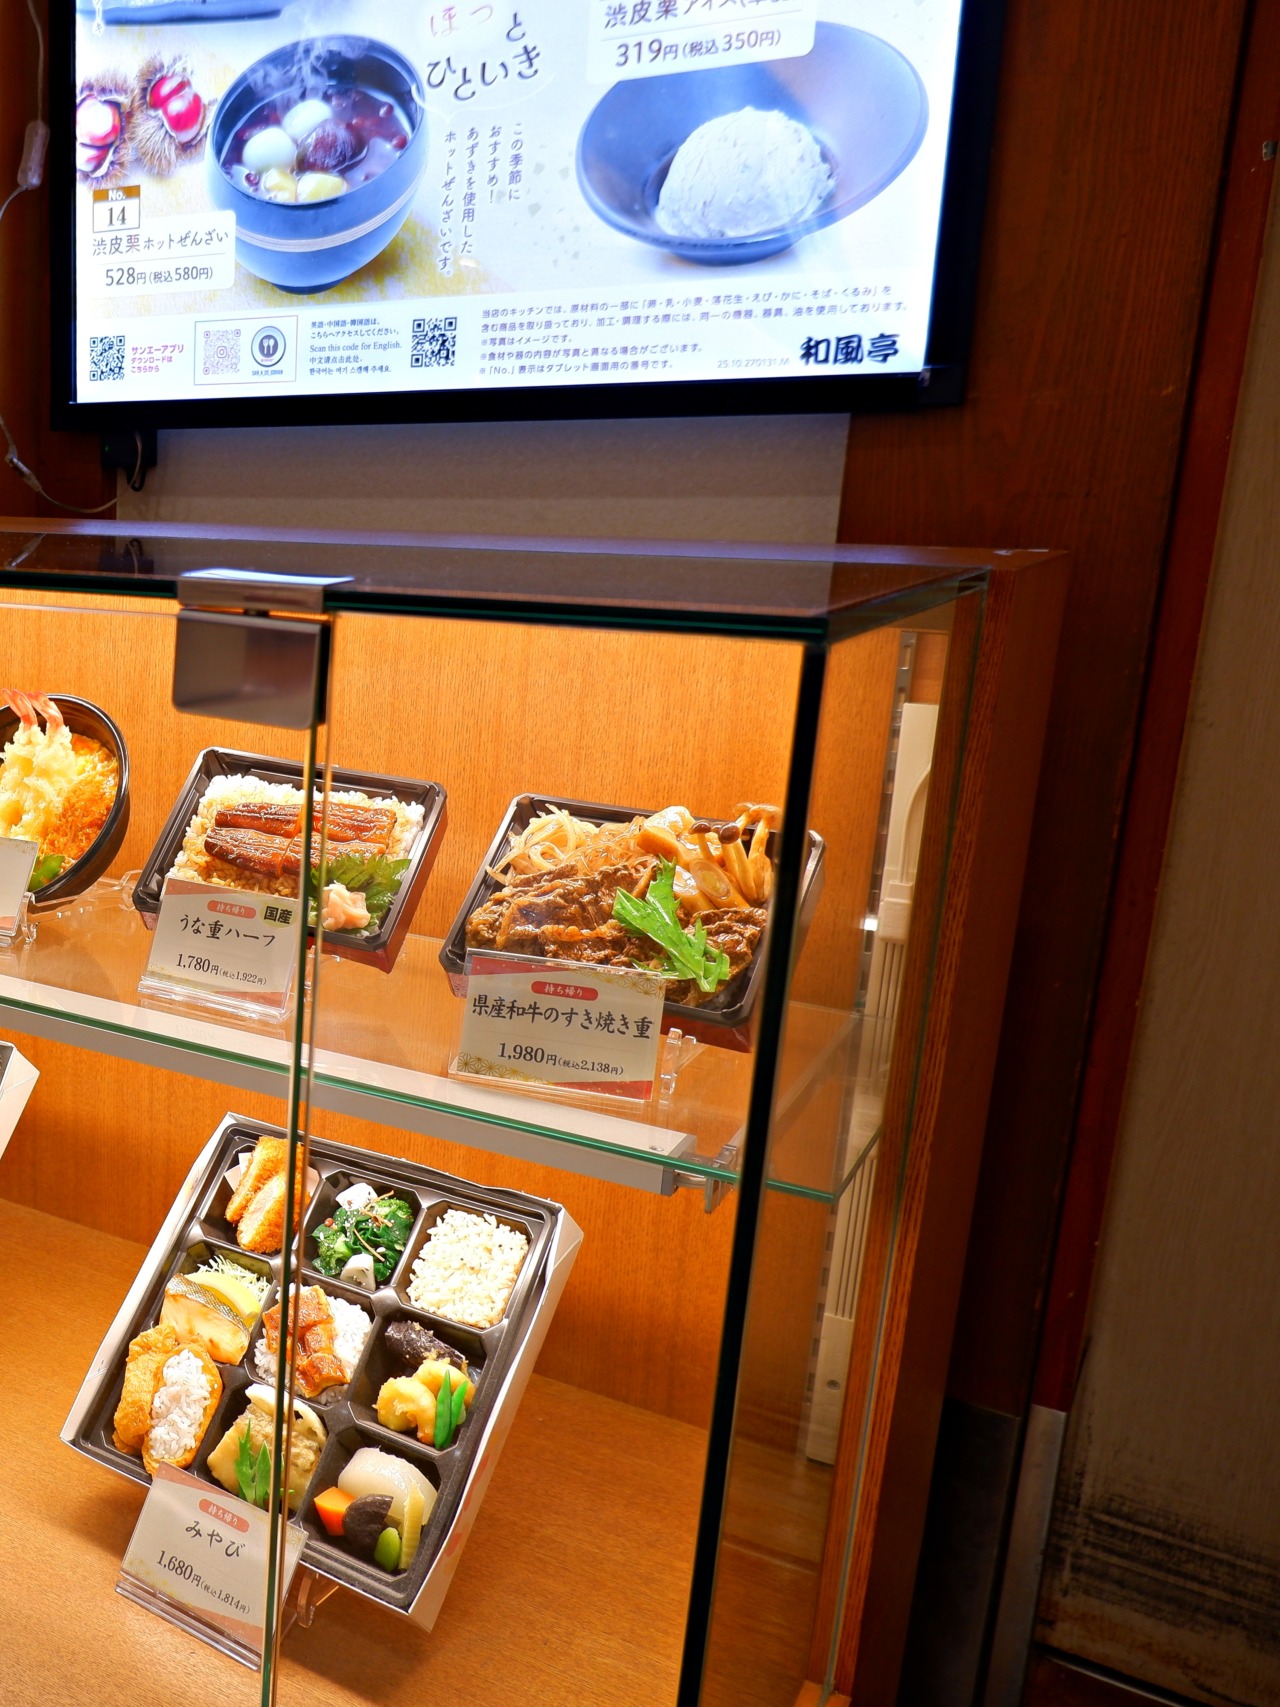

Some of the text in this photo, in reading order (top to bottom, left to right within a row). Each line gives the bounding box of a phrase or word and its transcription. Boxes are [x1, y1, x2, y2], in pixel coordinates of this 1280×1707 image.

[615, 29, 782, 67] 319円(税込350円)
[426, 44, 541, 101] ひといき
[507, 122, 524, 201] この季節に
[108, 190, 126, 201] No.
[438, 131, 457, 275] ホットぜんざいです。
[460, 127, 479, 254] あずきを使用した
[107, 206, 127, 226] 14
[105, 266, 214, 287] 528円(税込580円)
[130, 356, 173, 365] ダウンロードは
[131, 344, 185, 355] サンエーアプリ
[309, 341, 402, 353] Scan this code for English.
[800, 333, 900, 366] 和風亭
[130, 365, 160, 373] こちらから
[216, 901, 246, 915] 持ち帰り
[263, 905, 293, 925] 国産
[180, 914, 277, 948] うな重ハーフ
[175, 953, 268, 986] 1,780円(税込1,922円)
[543, 983, 584, 998] 持ち帰り
[472, 993, 654, 1040] 県産和牛のすき焼き重
[497, 1042, 624, 1076] 1,980円(税込2,138円)
[207, 1503, 239, 1526] 持ち帰り
[185, 1520, 247, 1558] みやび
[156, 1550, 252, 1615] 1,680円(税込1,814円)
